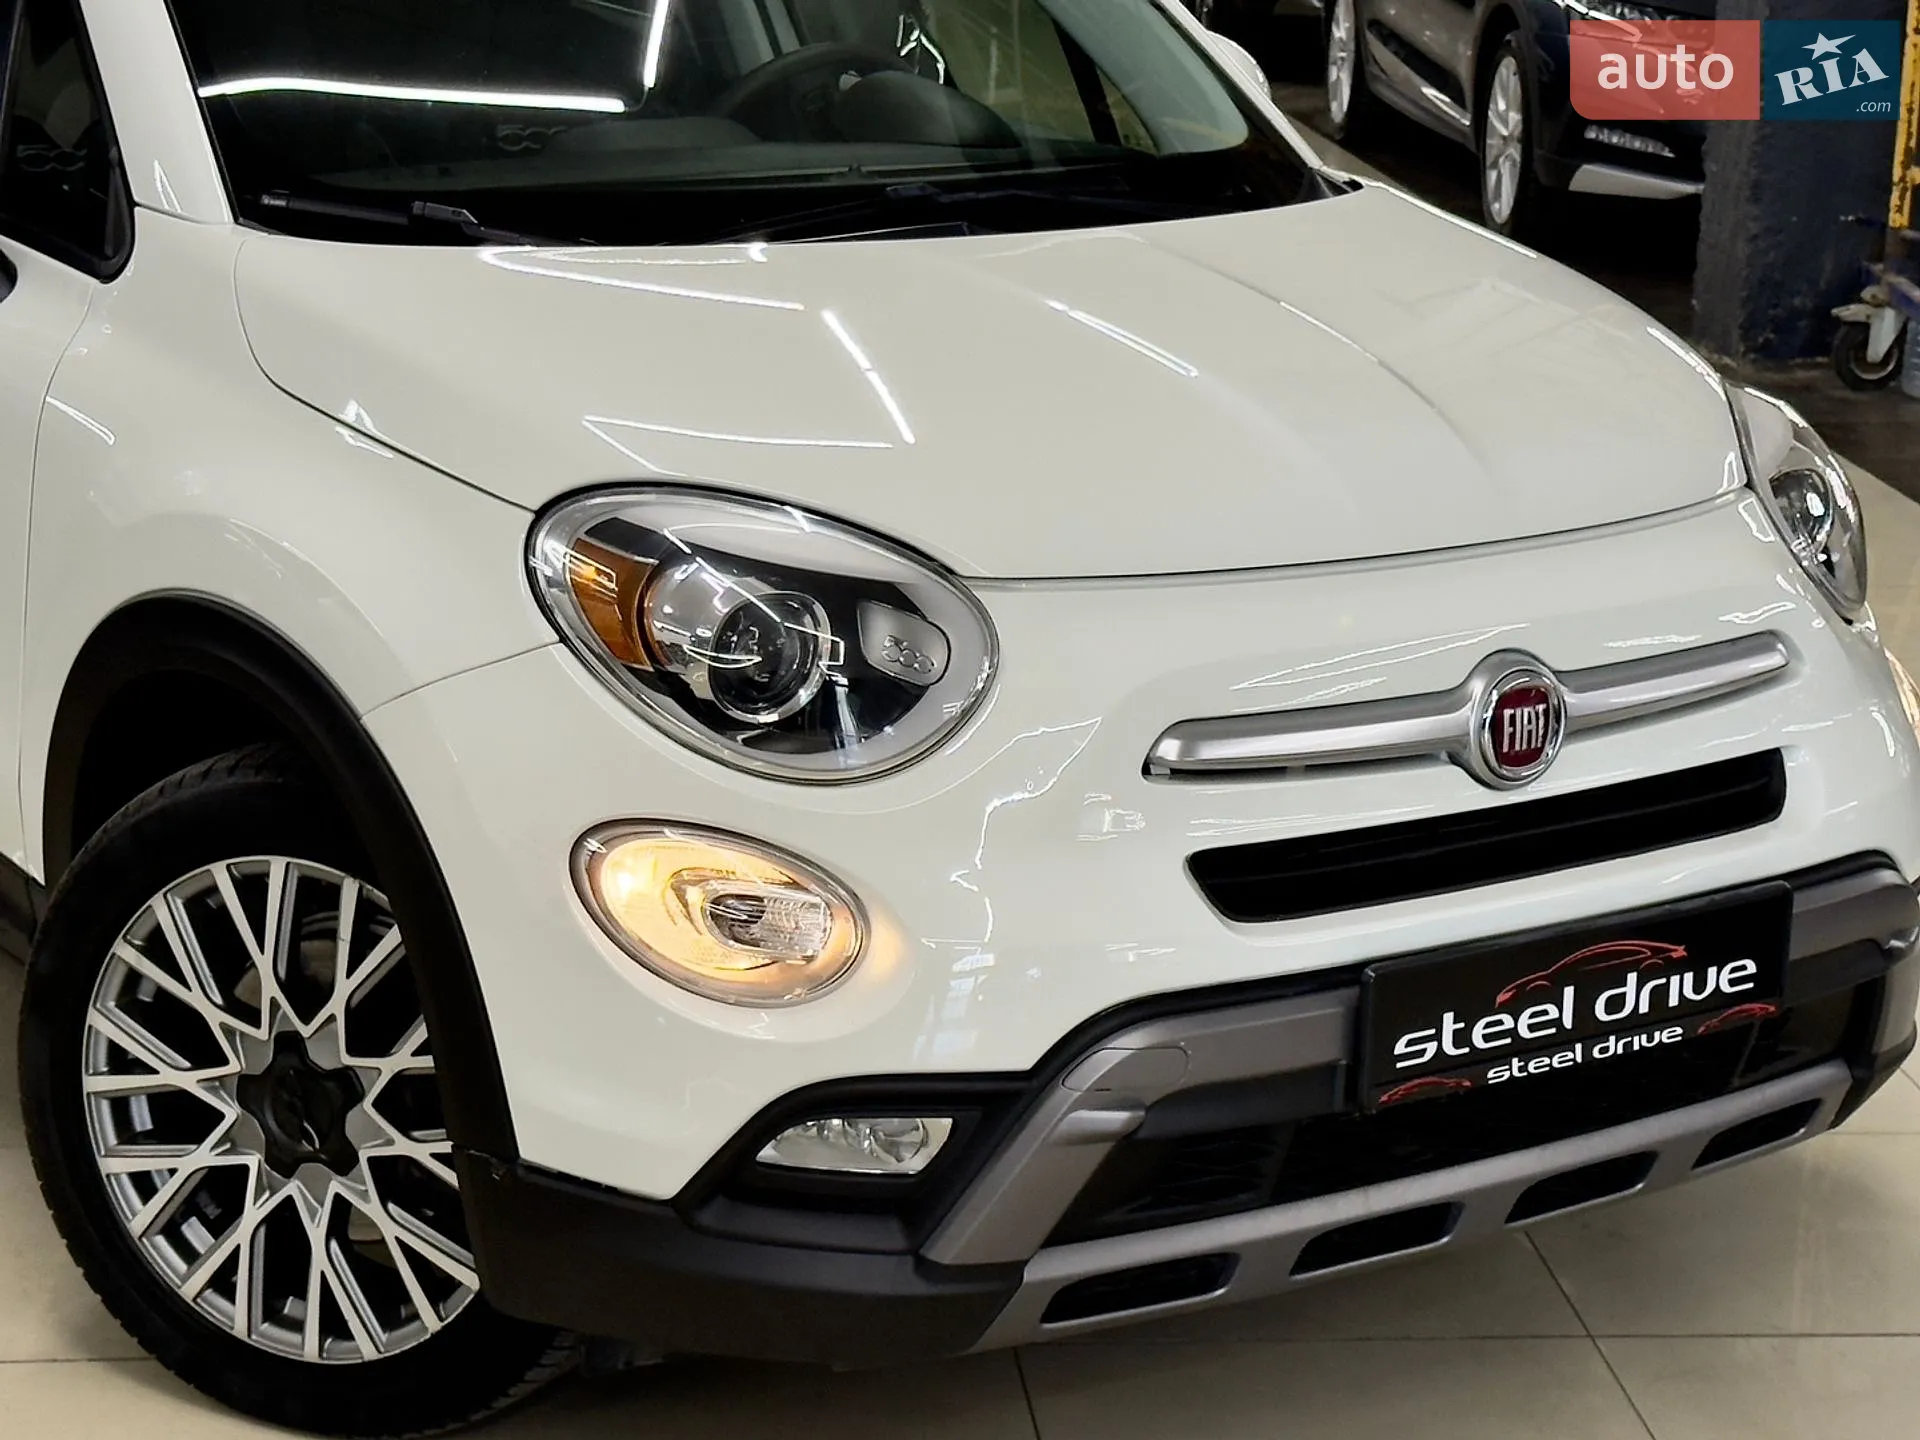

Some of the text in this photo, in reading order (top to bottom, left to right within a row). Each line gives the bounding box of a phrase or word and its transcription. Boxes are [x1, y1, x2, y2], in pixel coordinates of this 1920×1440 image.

[1502, 703, 1547, 753] FIAT
[1393, 958, 1758, 1069] steel drive
[1486, 1026, 1684, 1085] steel drive
